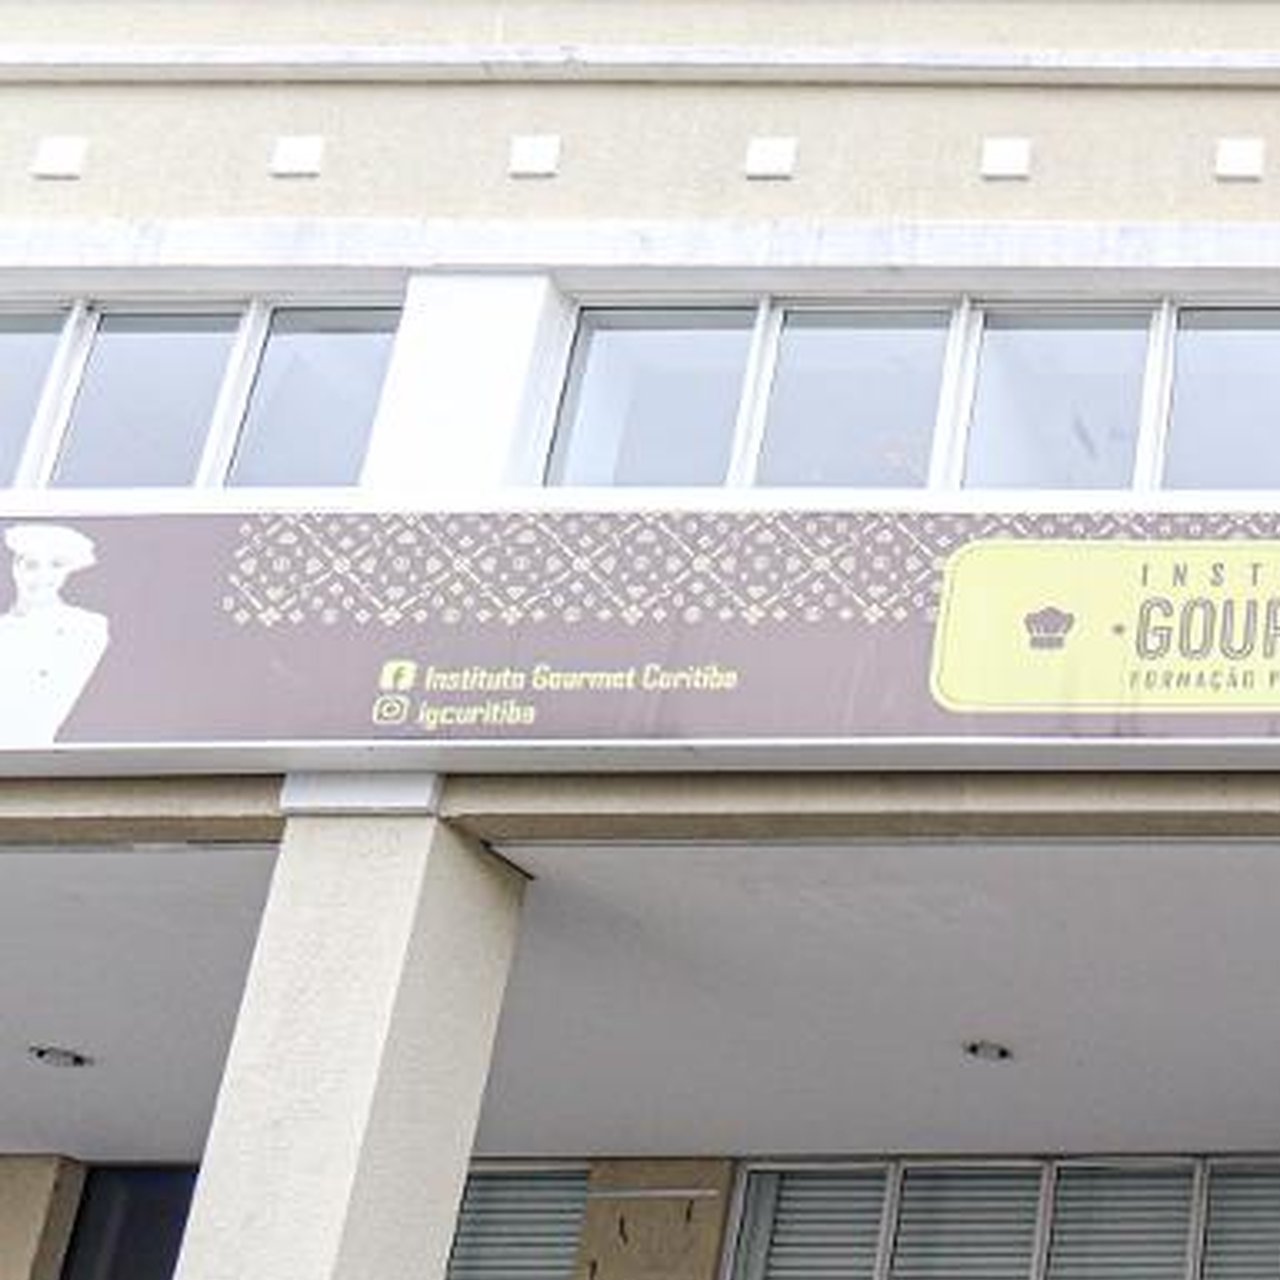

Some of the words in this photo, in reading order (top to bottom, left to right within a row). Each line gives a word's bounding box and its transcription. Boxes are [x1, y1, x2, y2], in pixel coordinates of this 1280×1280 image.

[425, 665, 525, 691] Instituto
[532, 663, 636, 690] Gourmet
[642, 663, 739, 689] Curitiba
[1129, 667, 1255, 691] FORMAÇÃO
[418, 700, 535, 730] igcuritiba
